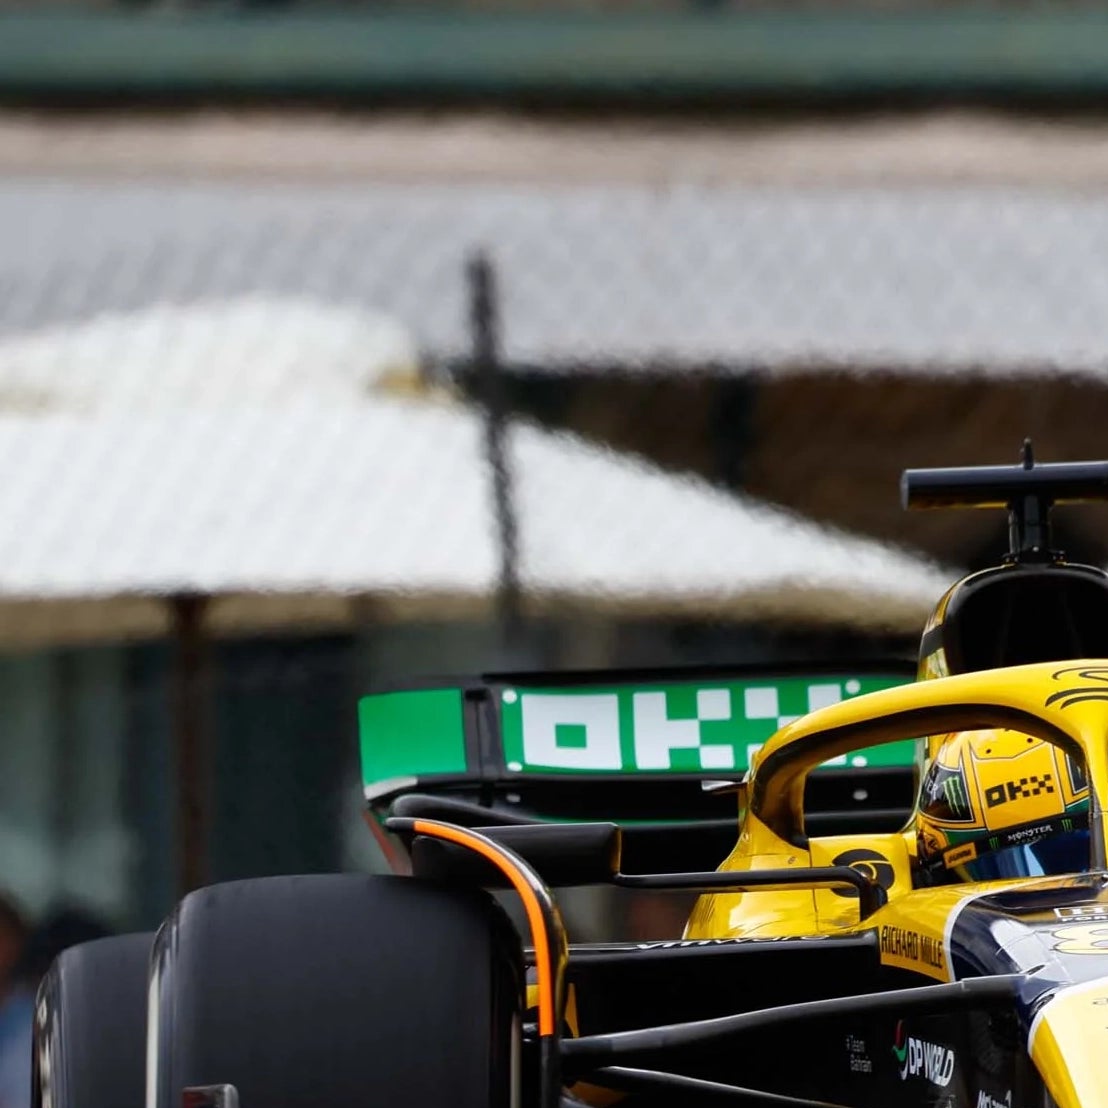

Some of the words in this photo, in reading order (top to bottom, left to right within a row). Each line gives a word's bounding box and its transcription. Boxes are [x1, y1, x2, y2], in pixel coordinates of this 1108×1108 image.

[985, 774, 1054, 808] OKX
[1007, 824, 1053, 841] MONSTER
[881, 925, 919, 960] RICHARD
[920, 935, 944, 969] MILLE
[908, 1037, 923, 1076] DP
